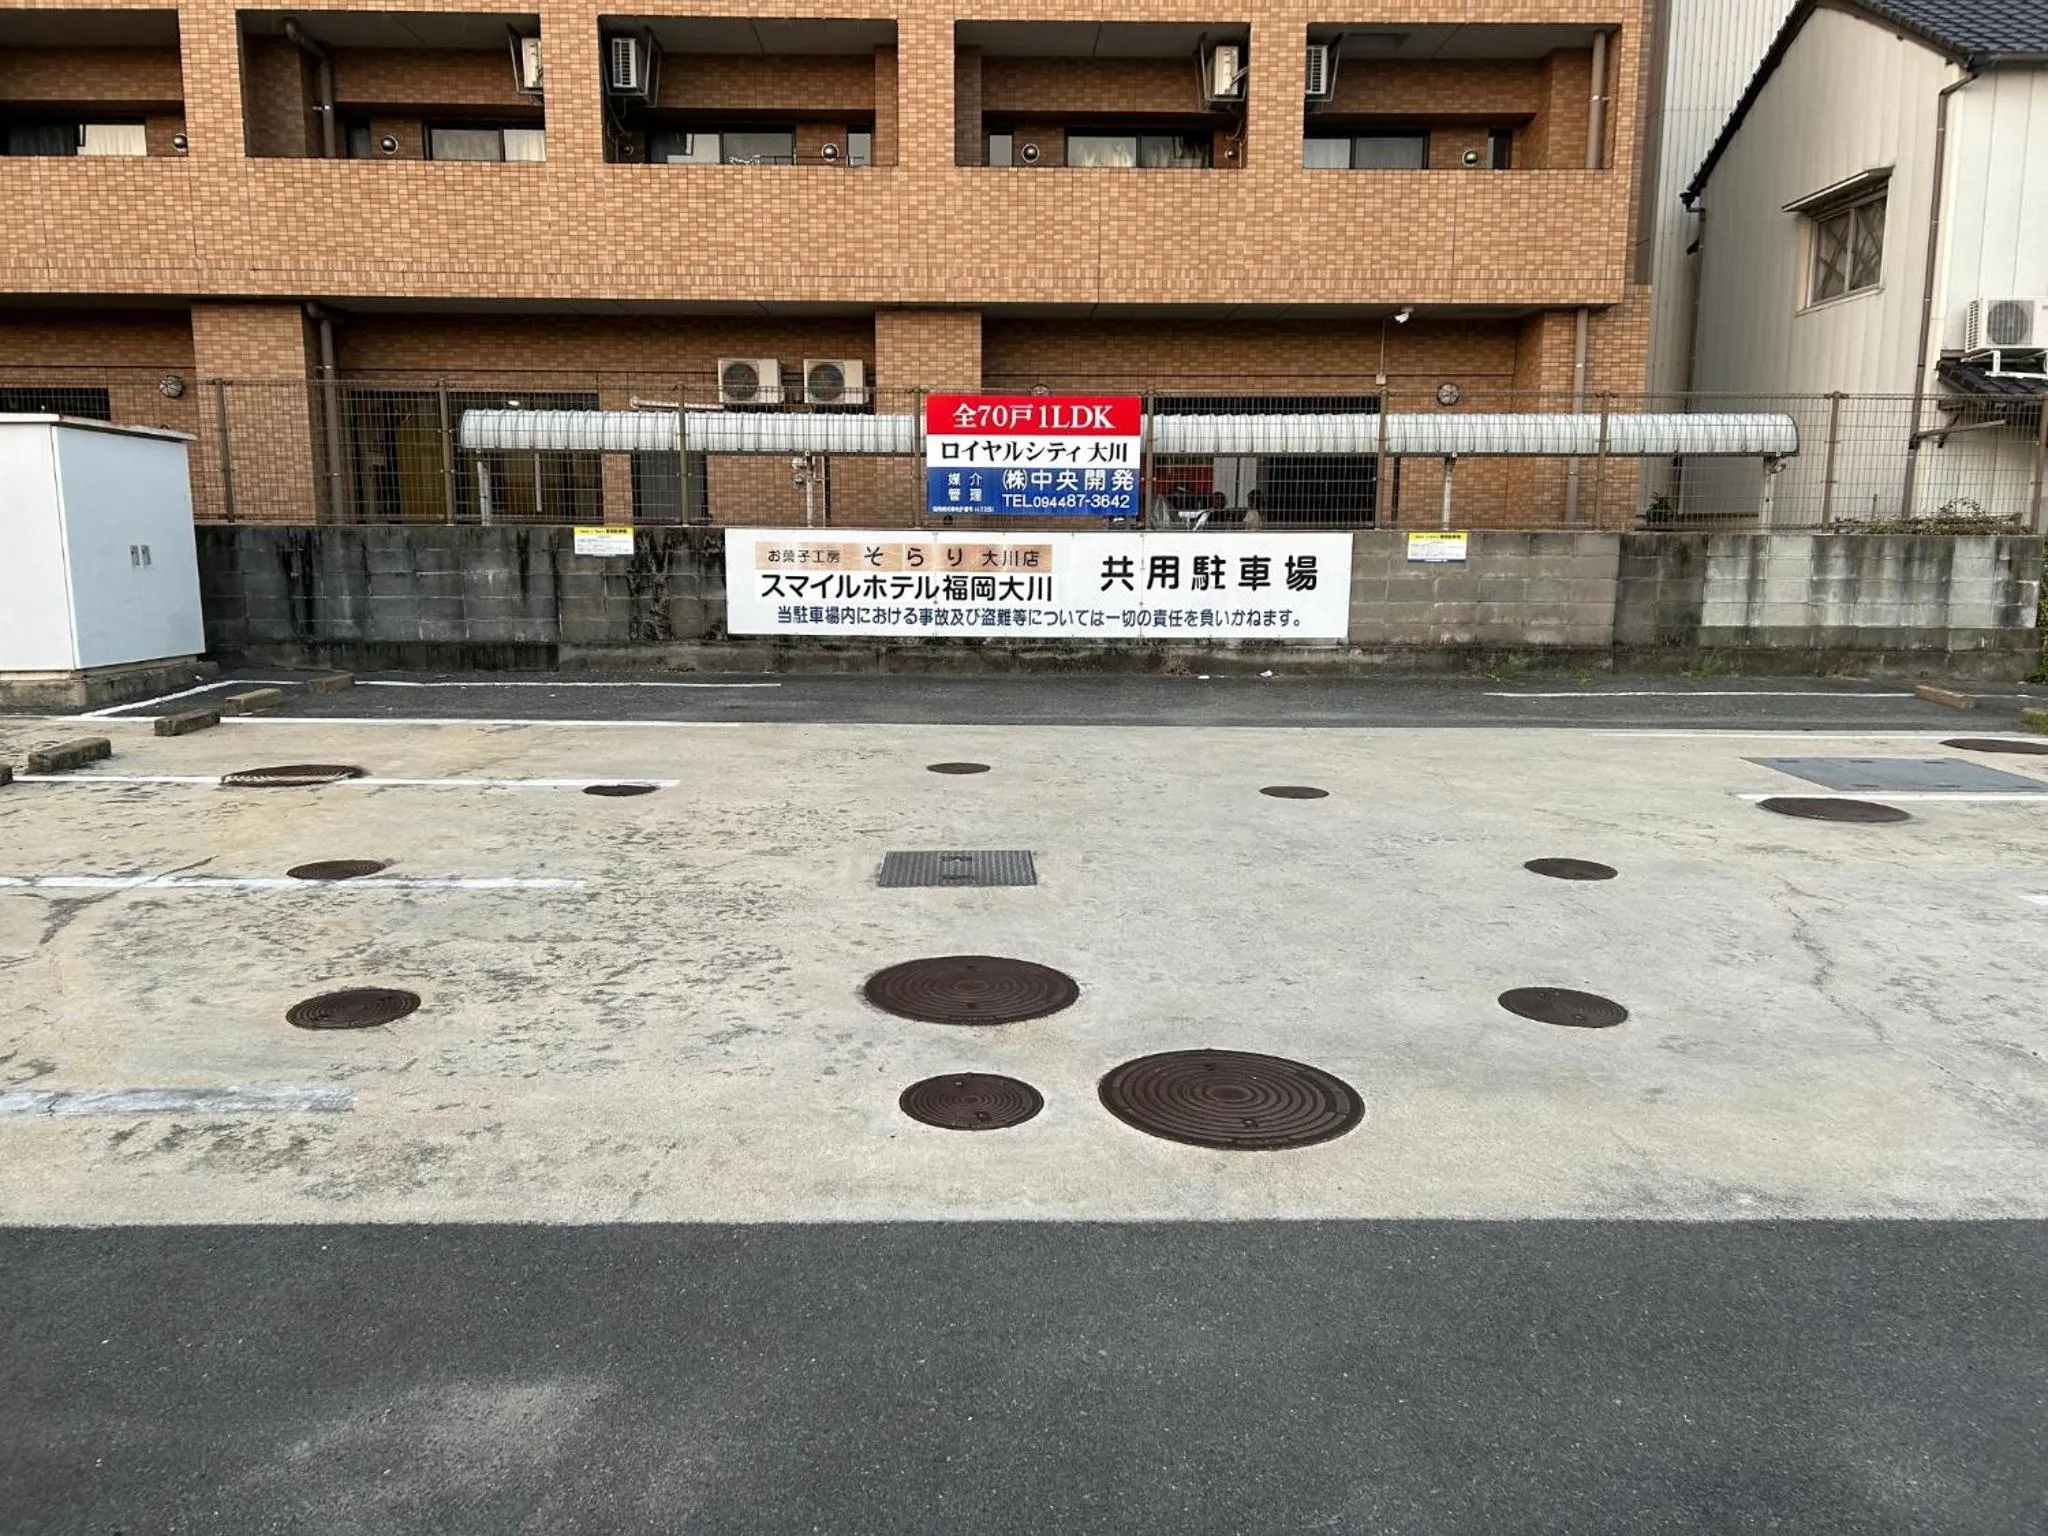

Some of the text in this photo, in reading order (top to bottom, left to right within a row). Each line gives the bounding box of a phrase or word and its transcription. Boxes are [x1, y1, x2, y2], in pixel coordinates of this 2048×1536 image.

[768, 549, 840, 564] お菓子工房
[982, 550, 1040, 567] 大川店
[1100, 554, 1318, 592] 共用駐車場
[761, 573, 1053, 602] スマイルホテル福岡大川
[778, 605, 1300, 628] 当駐車場内における事故及び盗難等については一切の責任を負いかねます。
